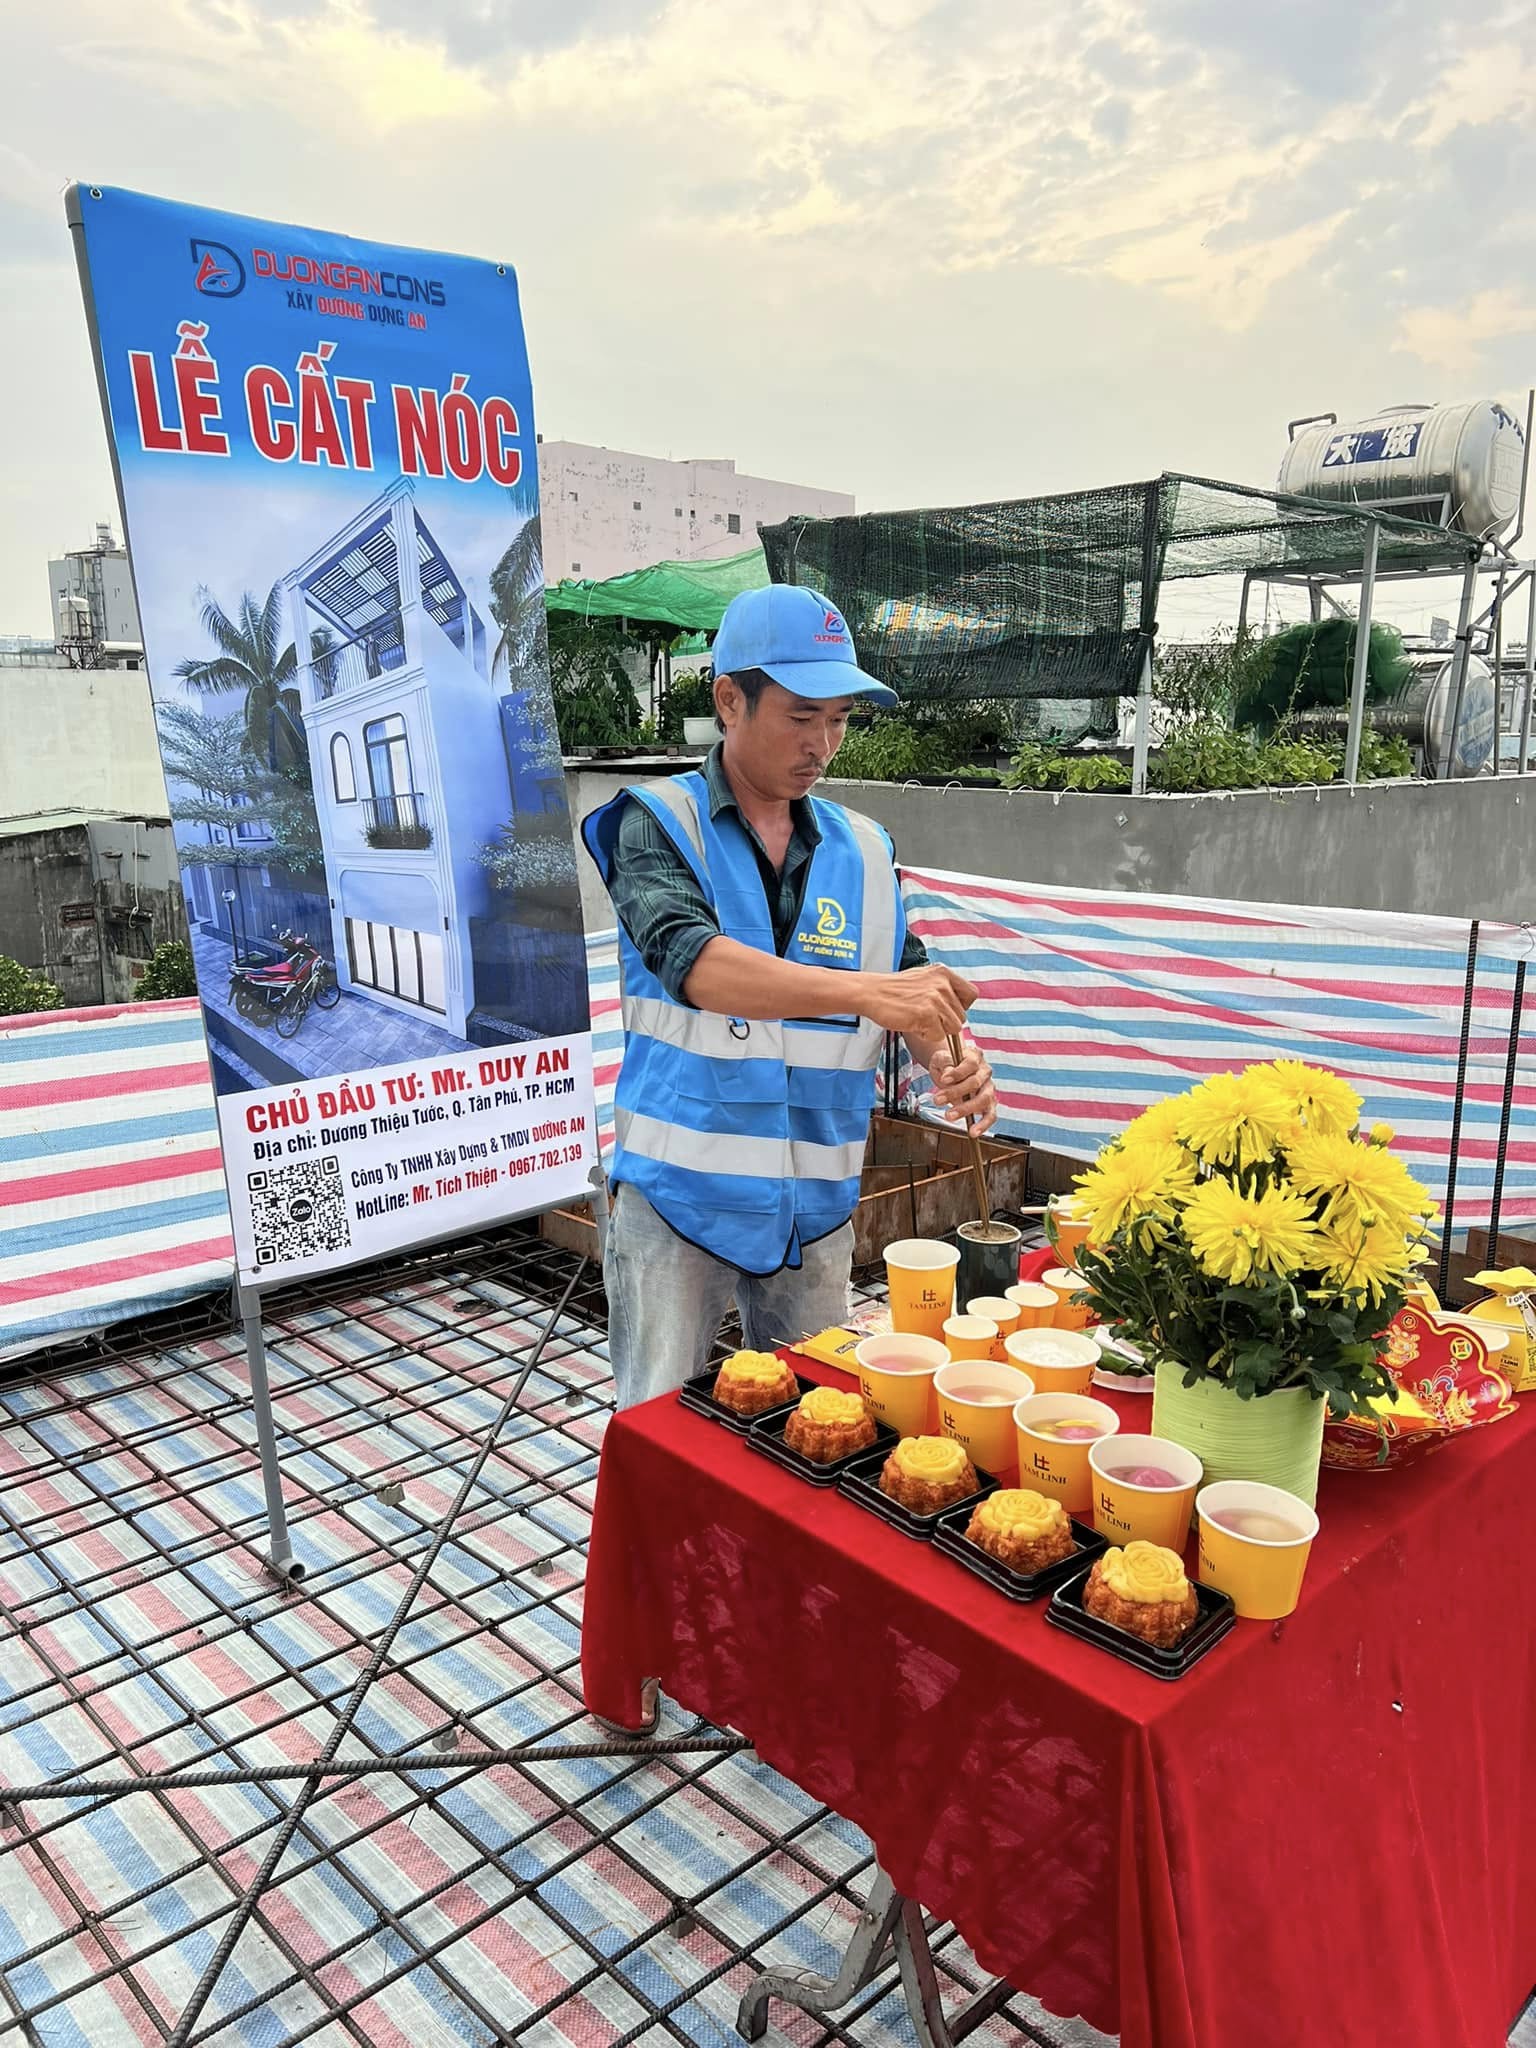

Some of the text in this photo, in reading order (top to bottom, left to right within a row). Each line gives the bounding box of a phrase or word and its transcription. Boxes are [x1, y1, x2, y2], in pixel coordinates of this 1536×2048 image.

[253, 249, 446, 306] DUONGANCONS
[286, 289, 313, 311] XÂY
[367, 304, 405, 326] DỰNG
[408, 311, 426, 330] AN
[128, 320, 523, 487] LỄ CẤT NÓC
[246, 1047, 569, 1133] CHỦ ĐẦU TƯ: Mr. DUY AN
[254, 1077, 575, 1162] Địa chỉ: Dương Thiệu Tước, Q. Tân Phú, TP. HCM
[351, 1168, 383, 1188] Công
[385, 1162, 398, 1181] Ty
[400, 1153, 433, 1176] TNHH
[435, 1148, 456, 1168] Xây
[458, 1142, 488, 1162] Dựng
[490, 1137, 499, 1153] &
[500, 1129, 530, 1150] TMDV
[570, 1116, 585, 1133] AN
[356, 1192, 409, 1220] HotLine:
[413, 1184, 432, 1204] Mr.
[465, 1167, 498, 1189] Thiện
[509, 1144, 582, 1178] 0967.702.139
